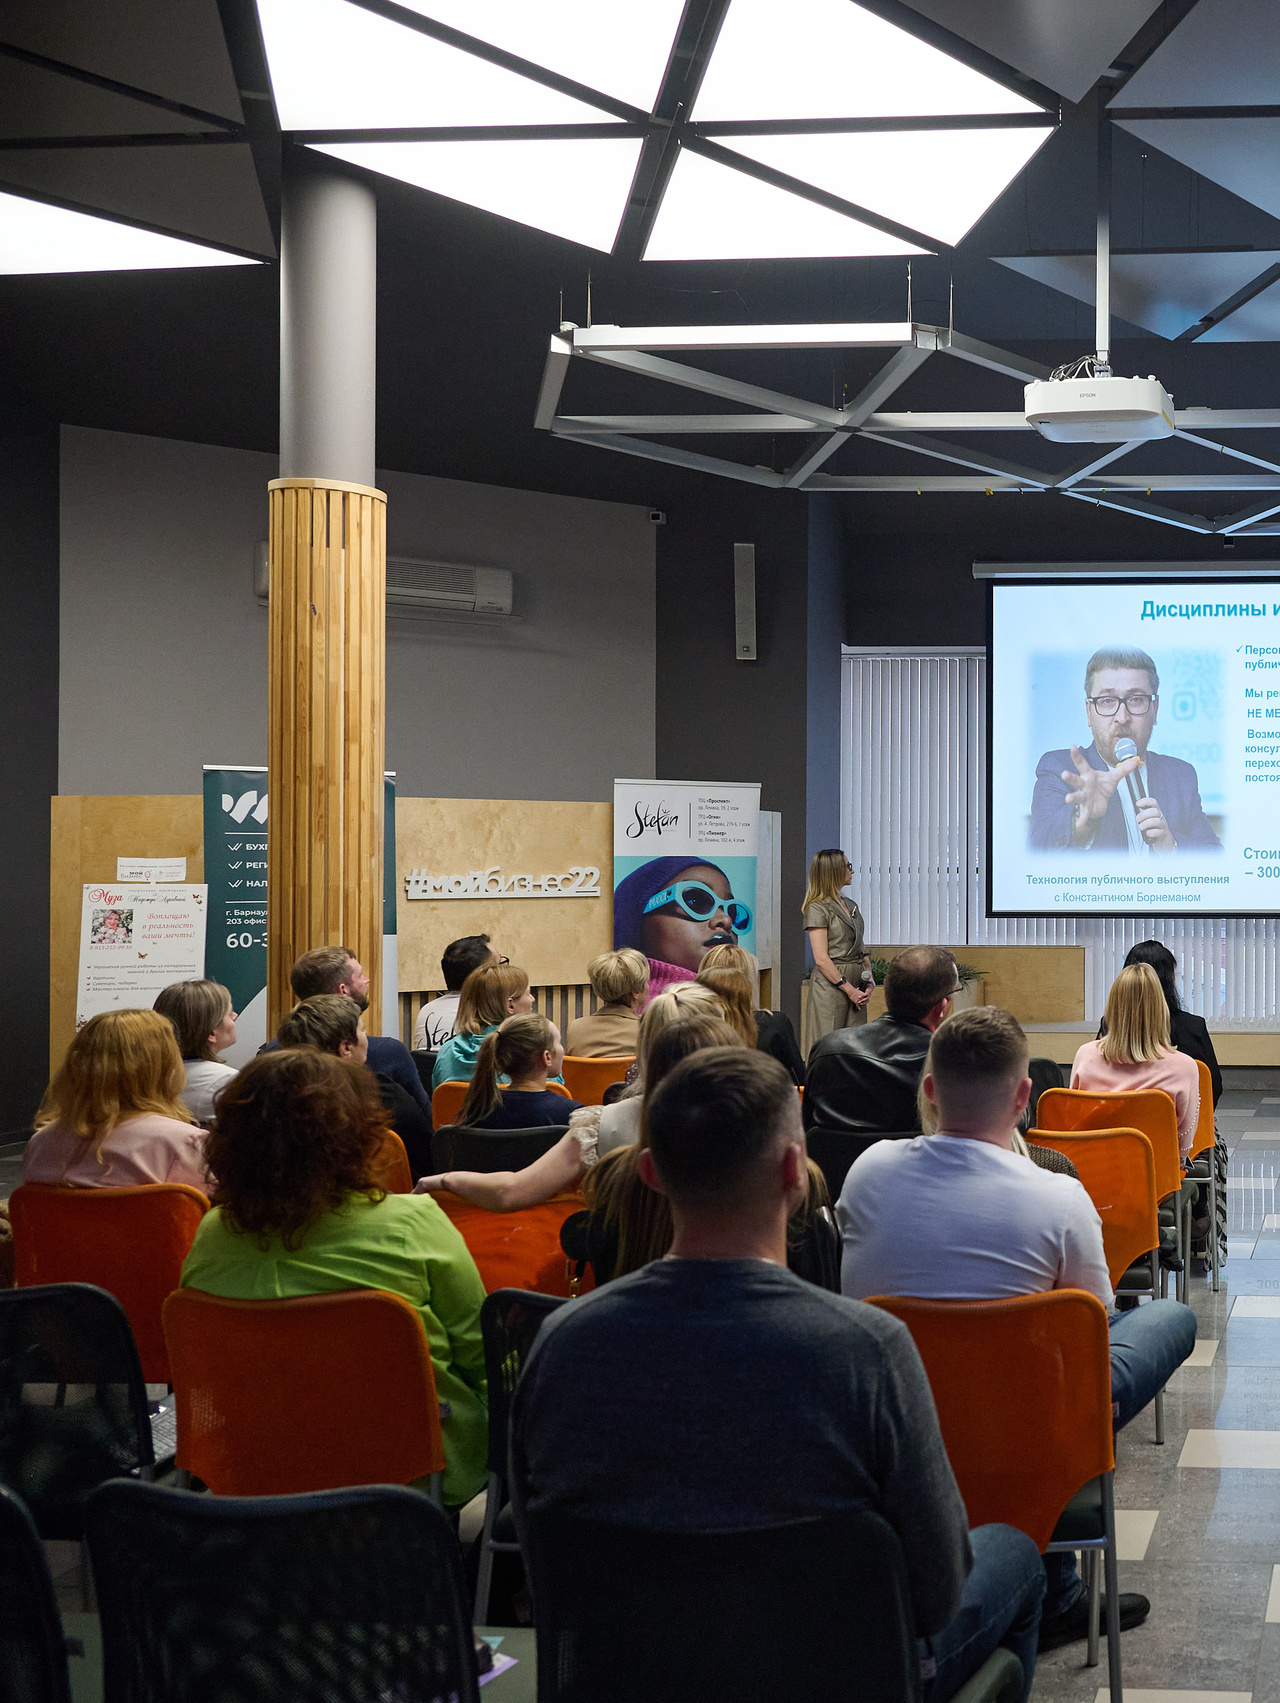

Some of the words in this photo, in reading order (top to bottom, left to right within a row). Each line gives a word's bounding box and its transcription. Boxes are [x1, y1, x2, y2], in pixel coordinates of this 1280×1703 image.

[1141, 601, 1266, 620] Дисциплины
[1245, 688, 1263, 698] Мы
[1247, 709, 1262, 718] НЕ
[626, 800, 679, 838] Stefan
[405, 866, 600, 898] #мойбизнес22
[1026, 875, 1087, 884] Технология
[1090, 874, 1154, 886] публичного
[1157, 875, 1229, 886] выступления
[88, 888, 123, 905] Муза
[1054, 894, 1060, 902] с
[1062, 892, 1133, 902] Константином
[1136, 891, 1200, 903] Борнеманом
[146, 912, 189, 920] Воплощаю
[148, 923, 194, 931] реальность
